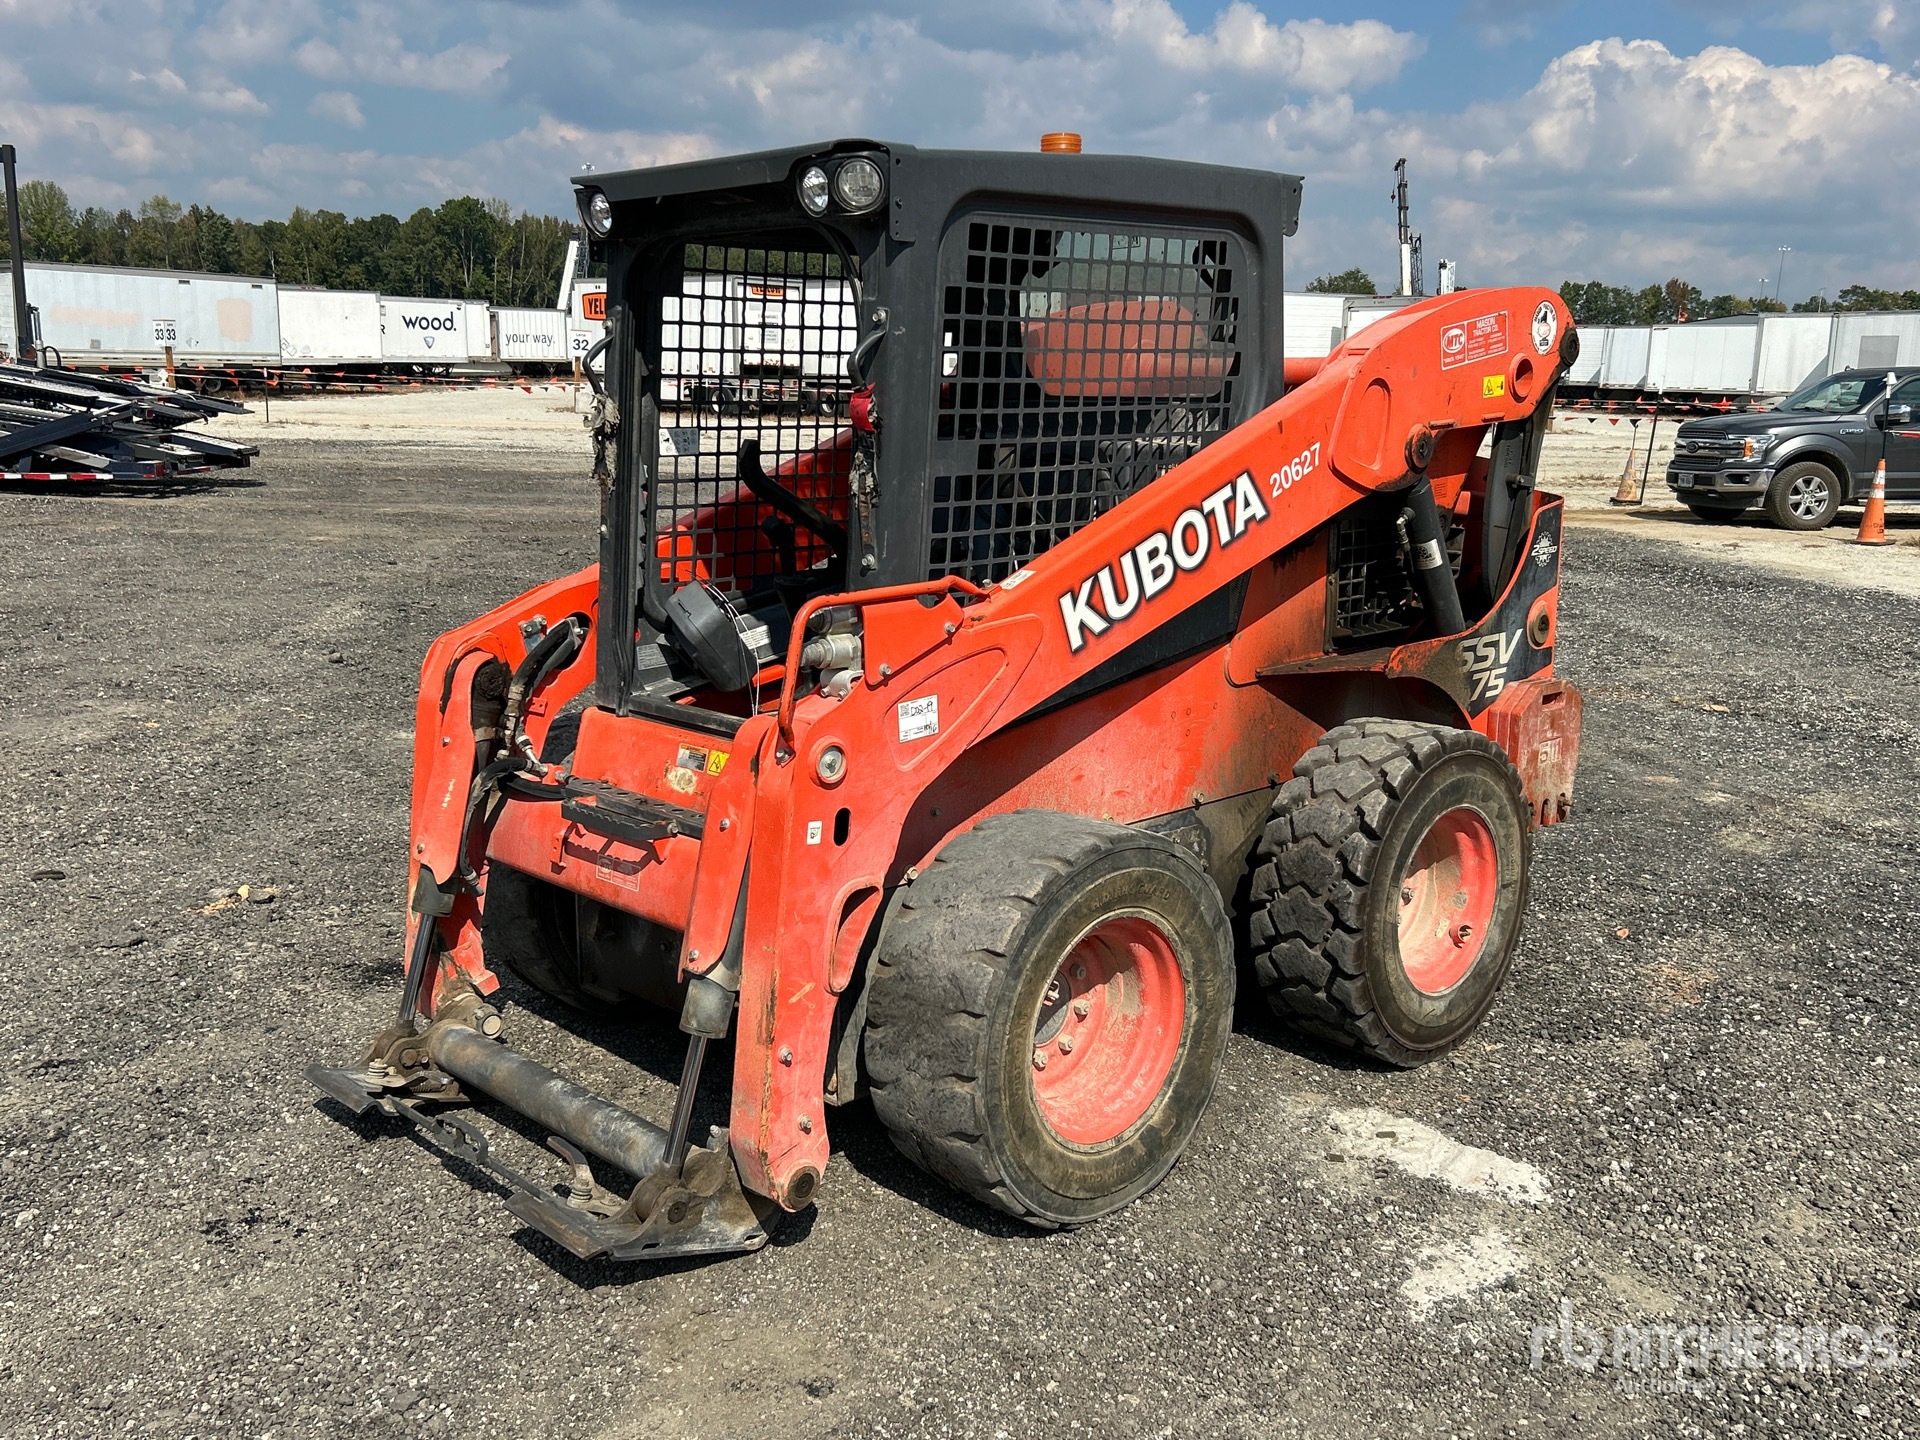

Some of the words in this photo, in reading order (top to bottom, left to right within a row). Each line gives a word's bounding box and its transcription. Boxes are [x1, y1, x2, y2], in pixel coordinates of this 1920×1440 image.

[402, 311, 457, 332] wood.
[154, 328, 165, 341] 33
[166, 328, 177, 341] 33
[505, 332, 531, 347] your
[572, 338, 589, 351] 32
[1269, 441, 1322, 499] 20627
[1057, 470, 1270, 654] KUBOTA
[1470, 667, 1507, 701] 75
